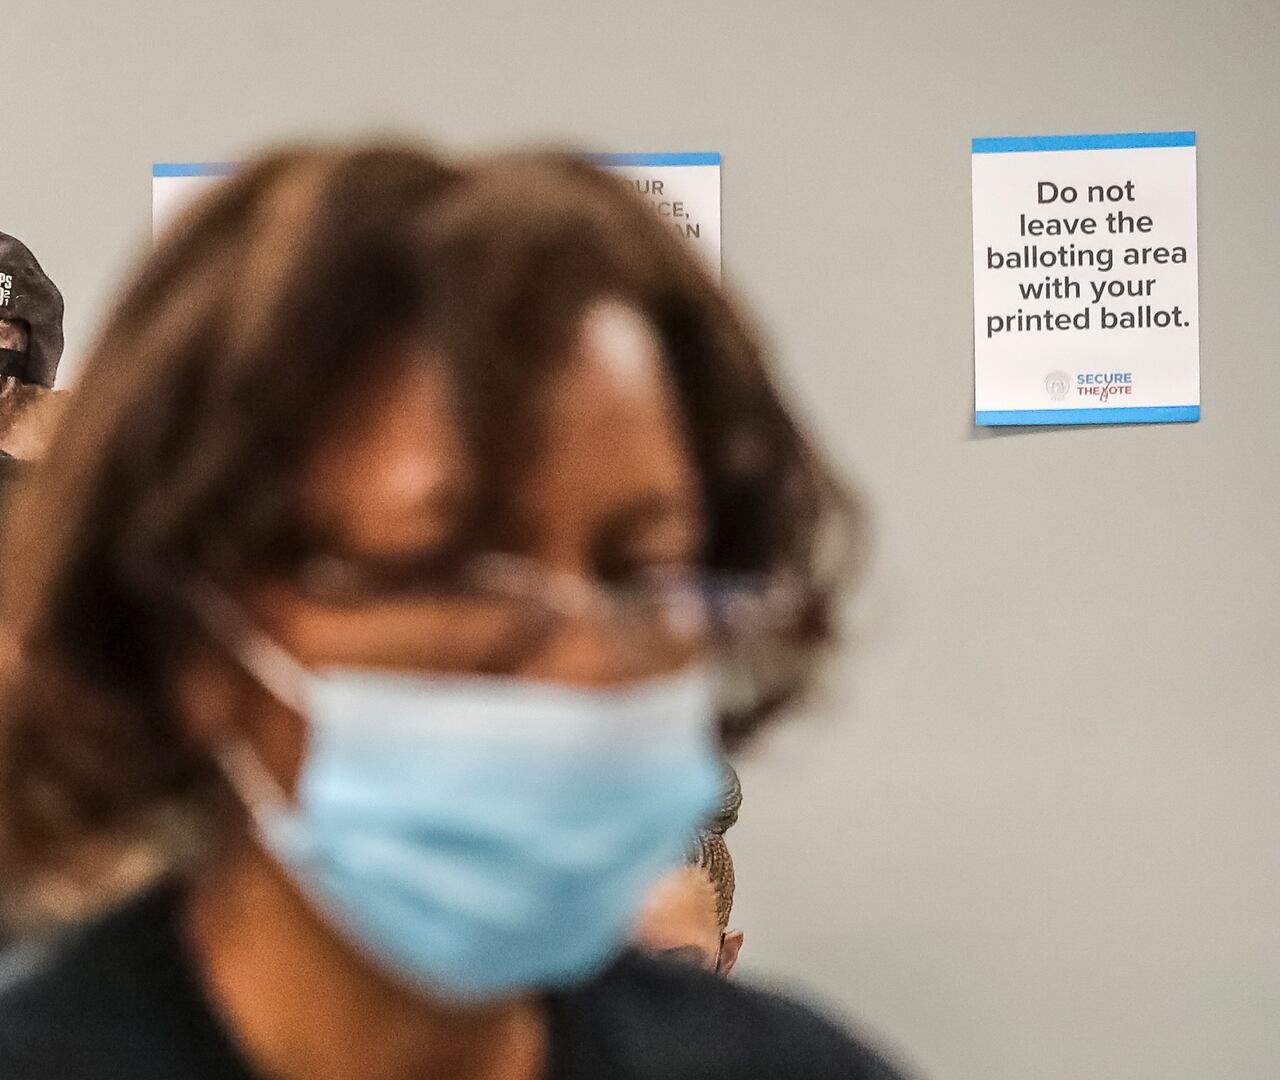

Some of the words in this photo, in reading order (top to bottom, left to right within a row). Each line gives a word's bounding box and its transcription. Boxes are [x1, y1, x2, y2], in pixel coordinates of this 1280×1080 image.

[1038, 181, 1077, 204] Do
[1088, 180, 1135, 203] not
[1020, 212, 1096, 237] leave
[1106, 210, 1153, 234] the
[987, 243, 1113, 274] balloting
[1124, 247, 1187, 265] area
[1019, 276, 1080, 300] with
[1090, 279, 1156, 305] your
[987, 307, 1090, 338] printed
[1102, 304, 1190, 330] ballot.
[1077, 373, 1132, 384] SECURE
[1077, 386, 1100, 395] THE
